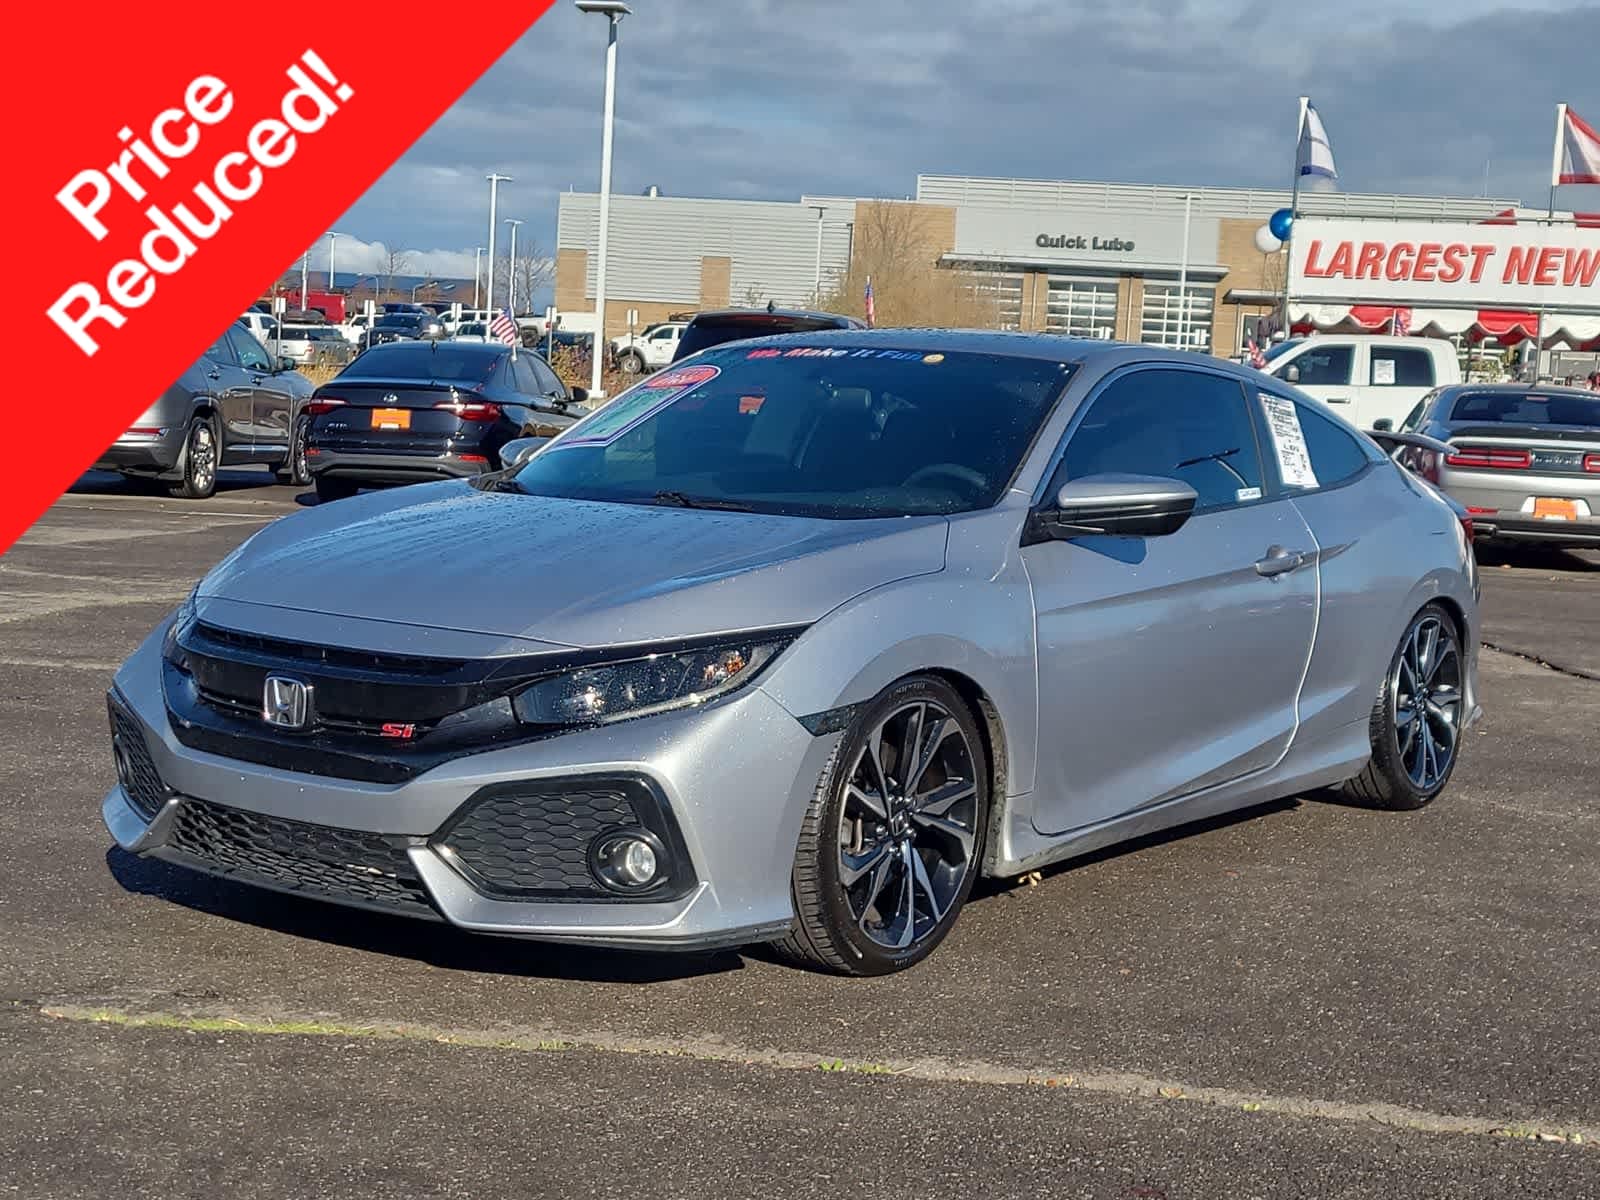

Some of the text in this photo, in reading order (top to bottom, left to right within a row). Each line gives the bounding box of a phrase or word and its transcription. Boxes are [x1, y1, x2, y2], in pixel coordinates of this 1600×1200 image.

[1036, 233, 1135, 251] Quick Lube
[1303, 240, 1600, 287] LARGEST NEW
[784, 348, 848, 358] Make
[381, 723, 415, 738] Si
